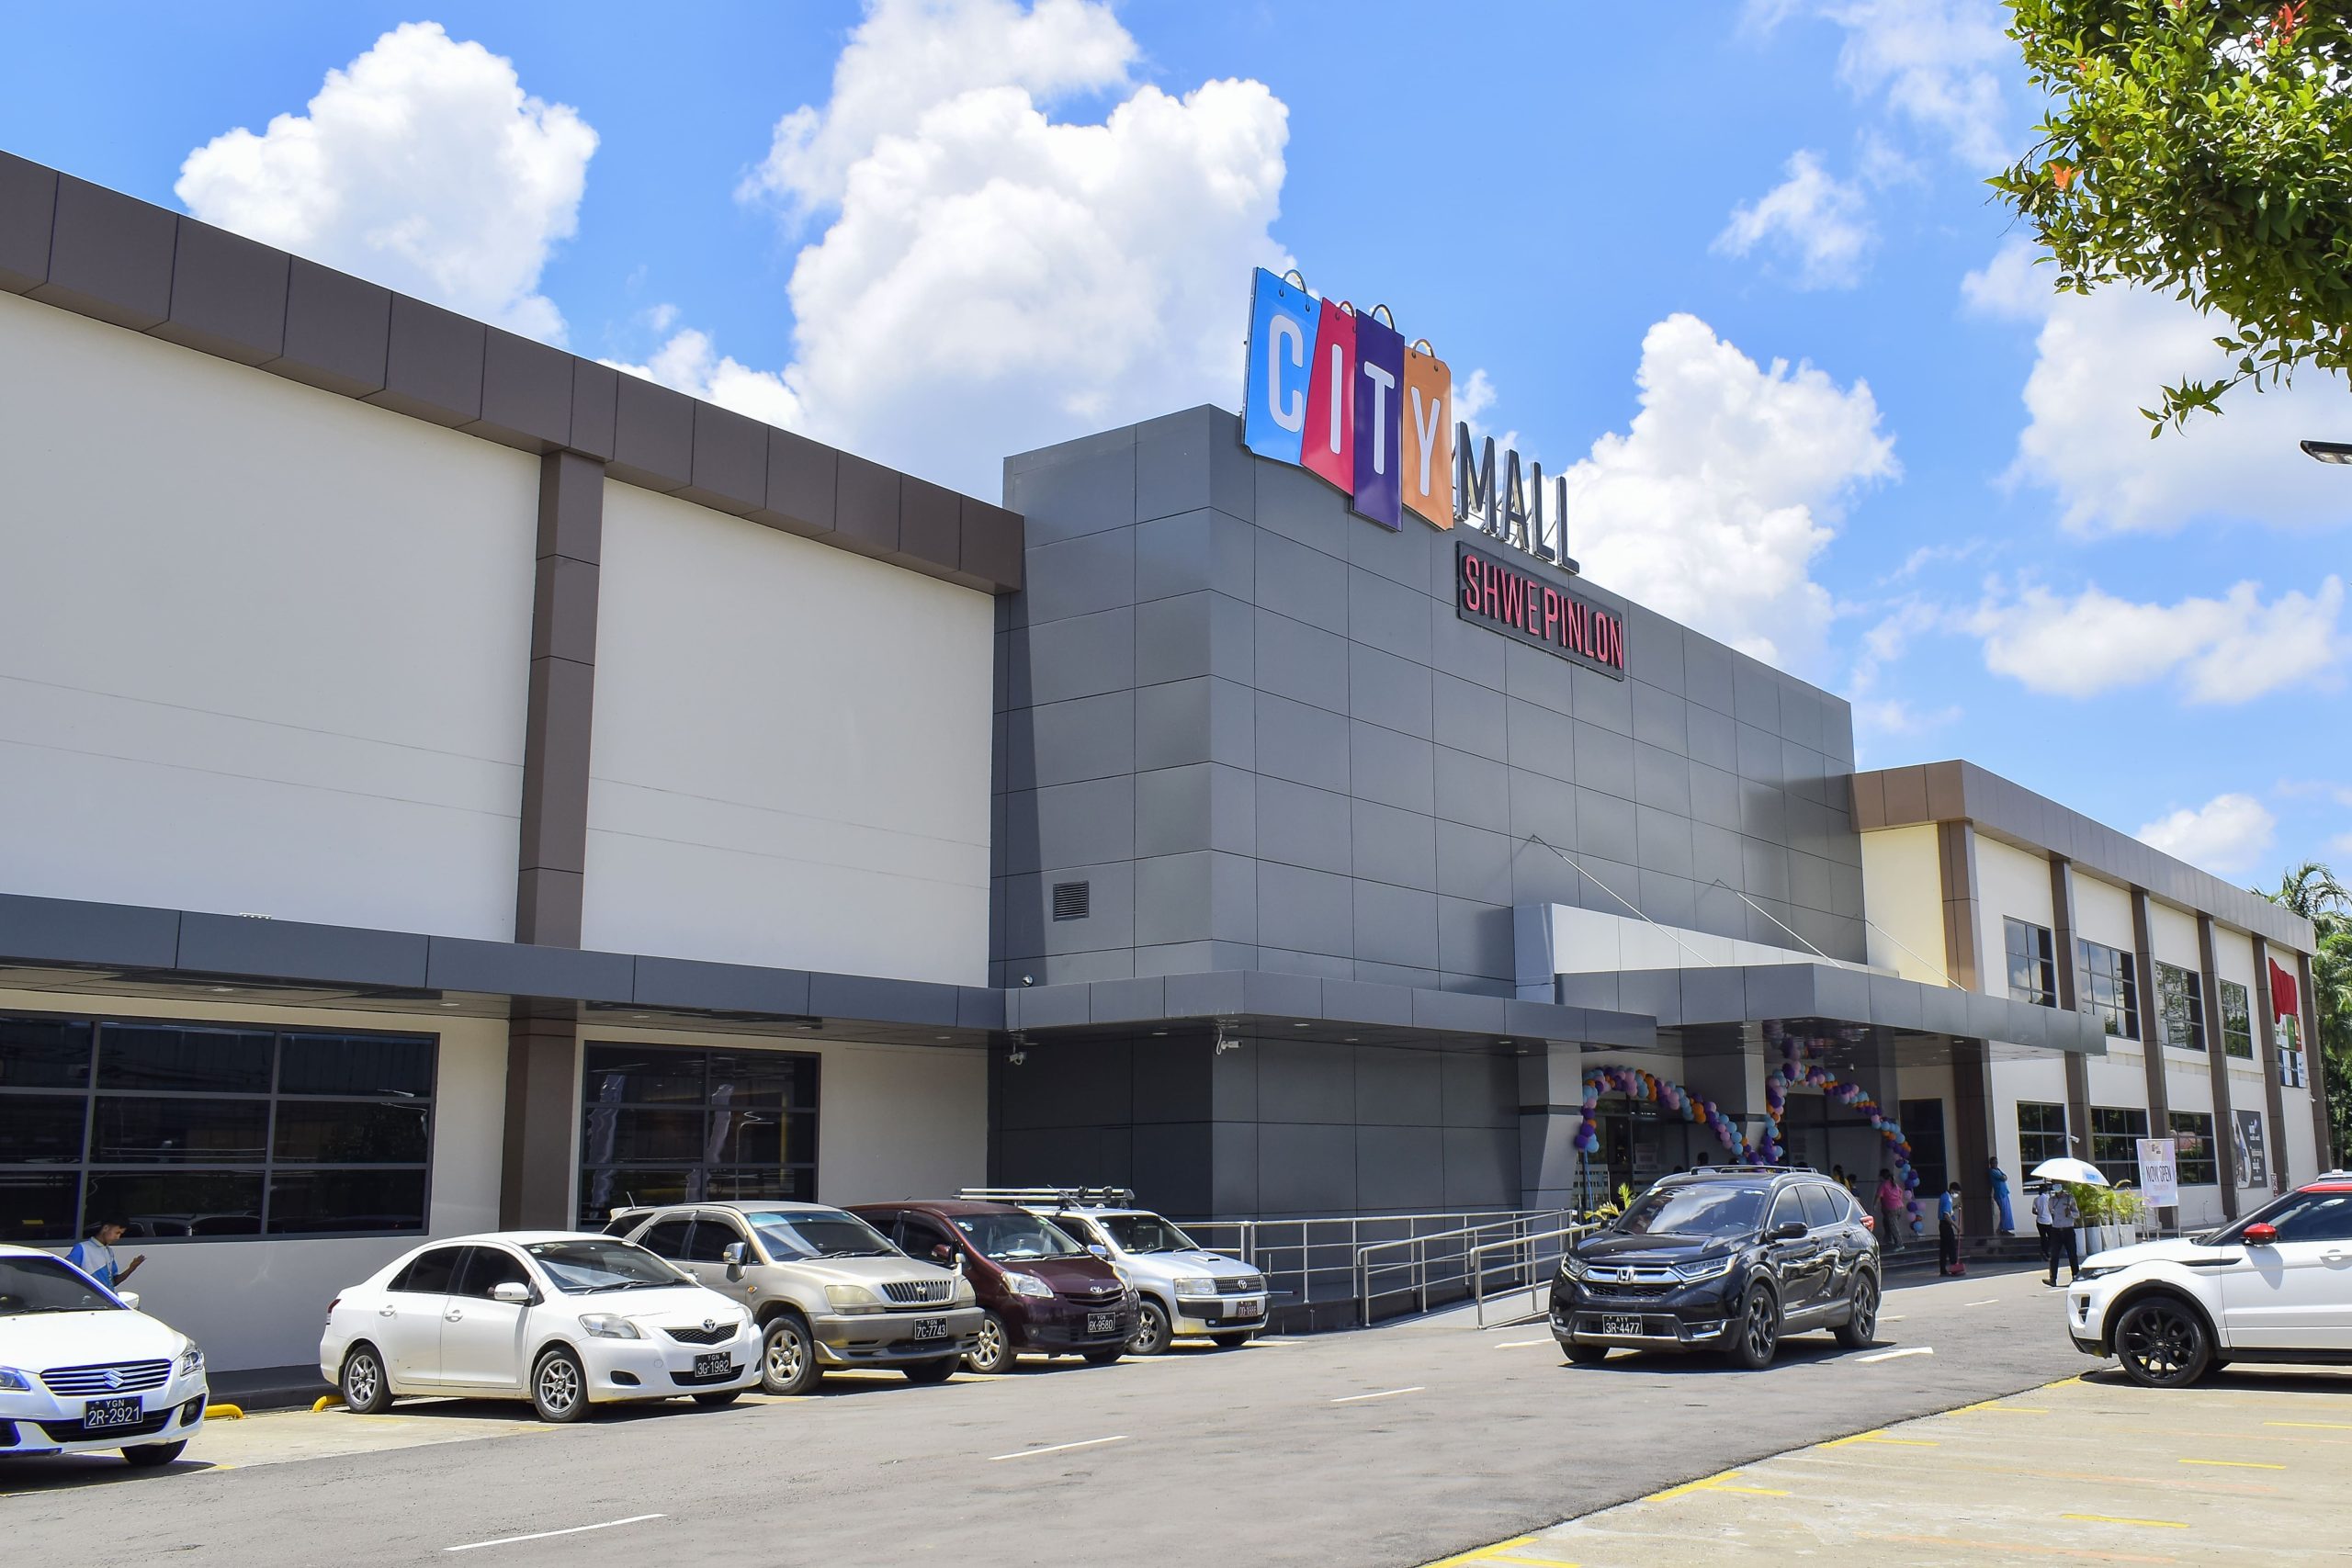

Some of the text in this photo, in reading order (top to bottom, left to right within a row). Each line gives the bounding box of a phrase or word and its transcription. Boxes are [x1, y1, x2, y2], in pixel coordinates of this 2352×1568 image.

[1269, 314, 1579, 575] CITY MALL
[2146, 1165, 2172, 1182] NOW OPEN
[917, 1325, 945, 1337] 7C-7743
[1606, 1323, 1640, 1333] 3R-4477
[698, 1360, 729, 1375] 3G-1982
[106, 1399, 125, 1407] YGN
[88, 1406, 140, 1426] 2R-2921
